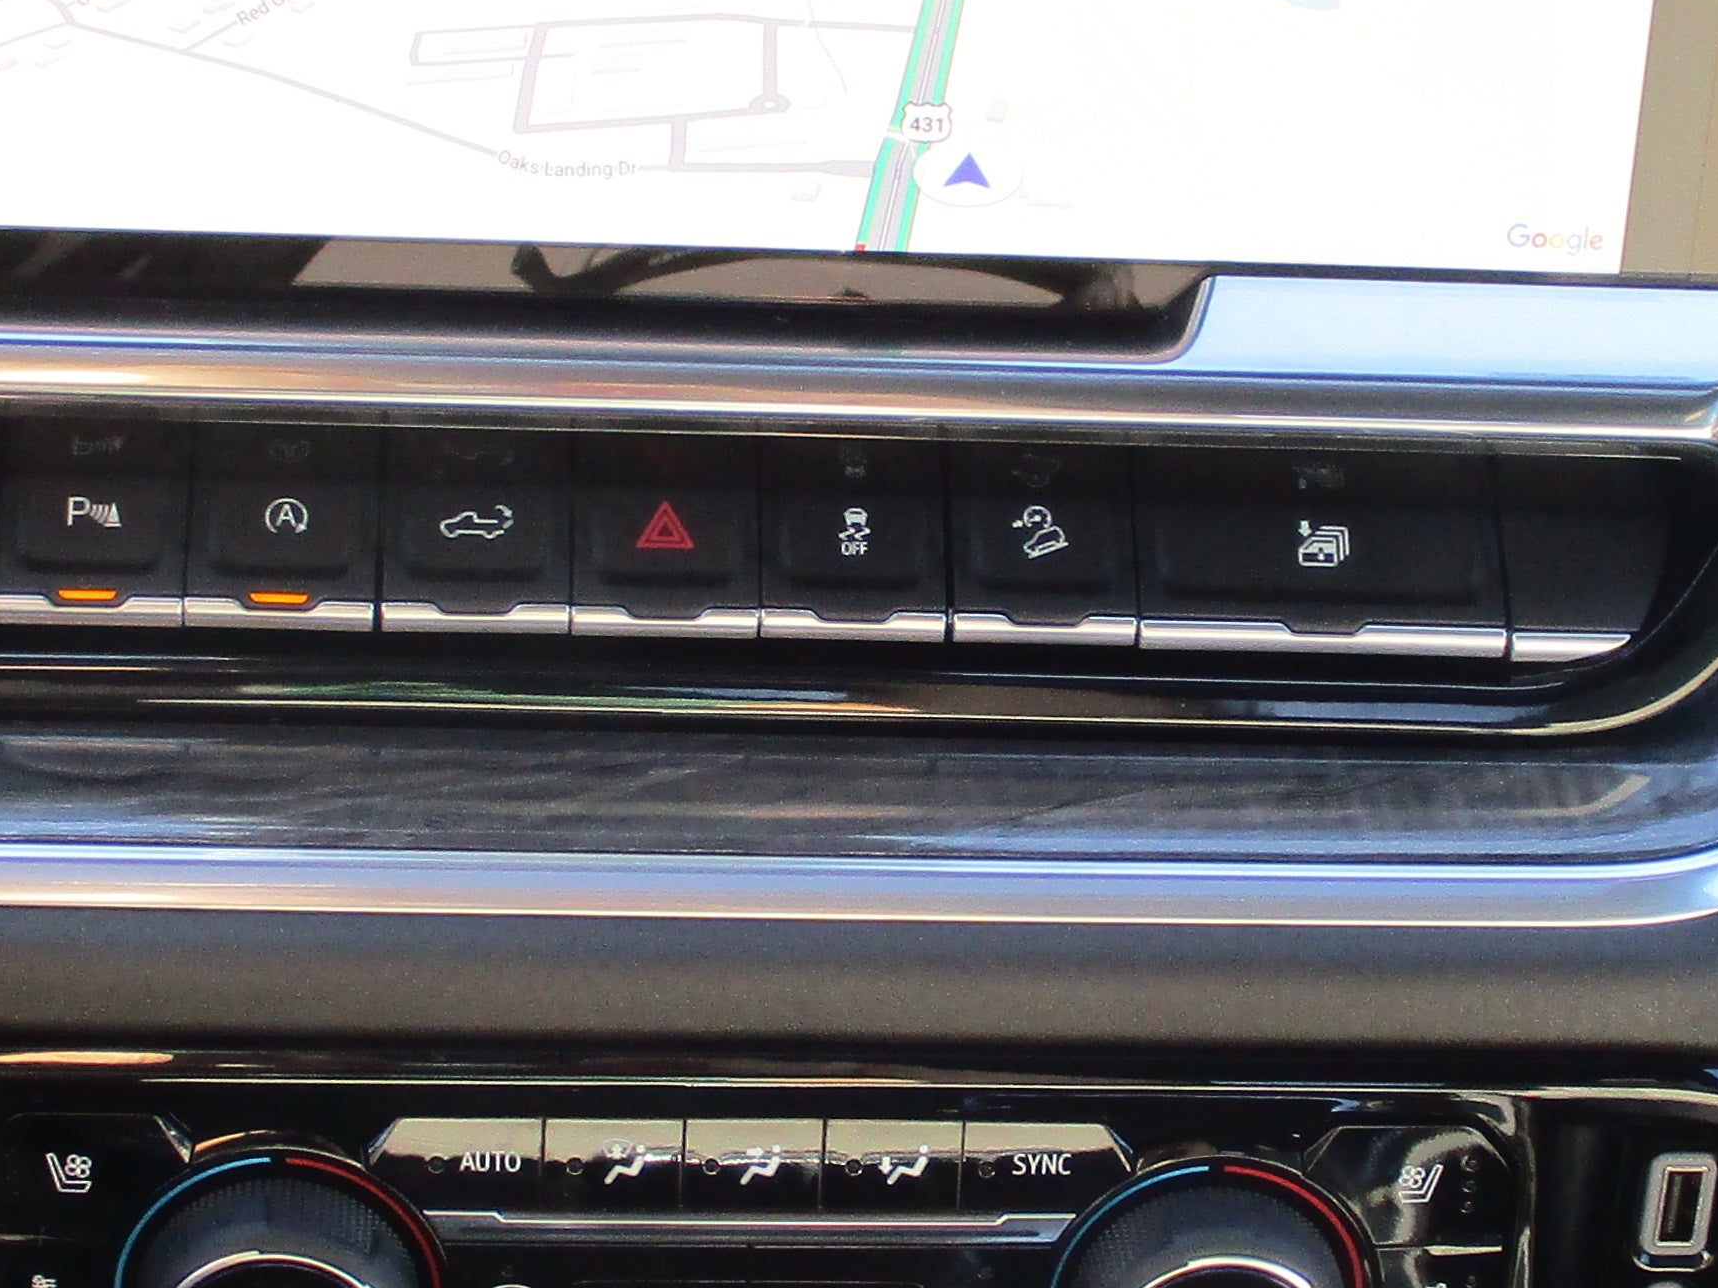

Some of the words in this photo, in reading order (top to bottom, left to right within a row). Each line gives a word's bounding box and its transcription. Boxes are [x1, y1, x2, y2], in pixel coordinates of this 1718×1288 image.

[908, 114, 946, 135] 431
[497, 149, 540, 175] Oaks
[544, 161, 614, 180] Landing
[618, 160, 638, 176] Dr
[1506, 222, 1605, 255] Google
[840, 539, 870, 557] OFF
[458, 1150, 522, 1174] AUTO
[1010, 1151, 1072, 1176] SYNC
